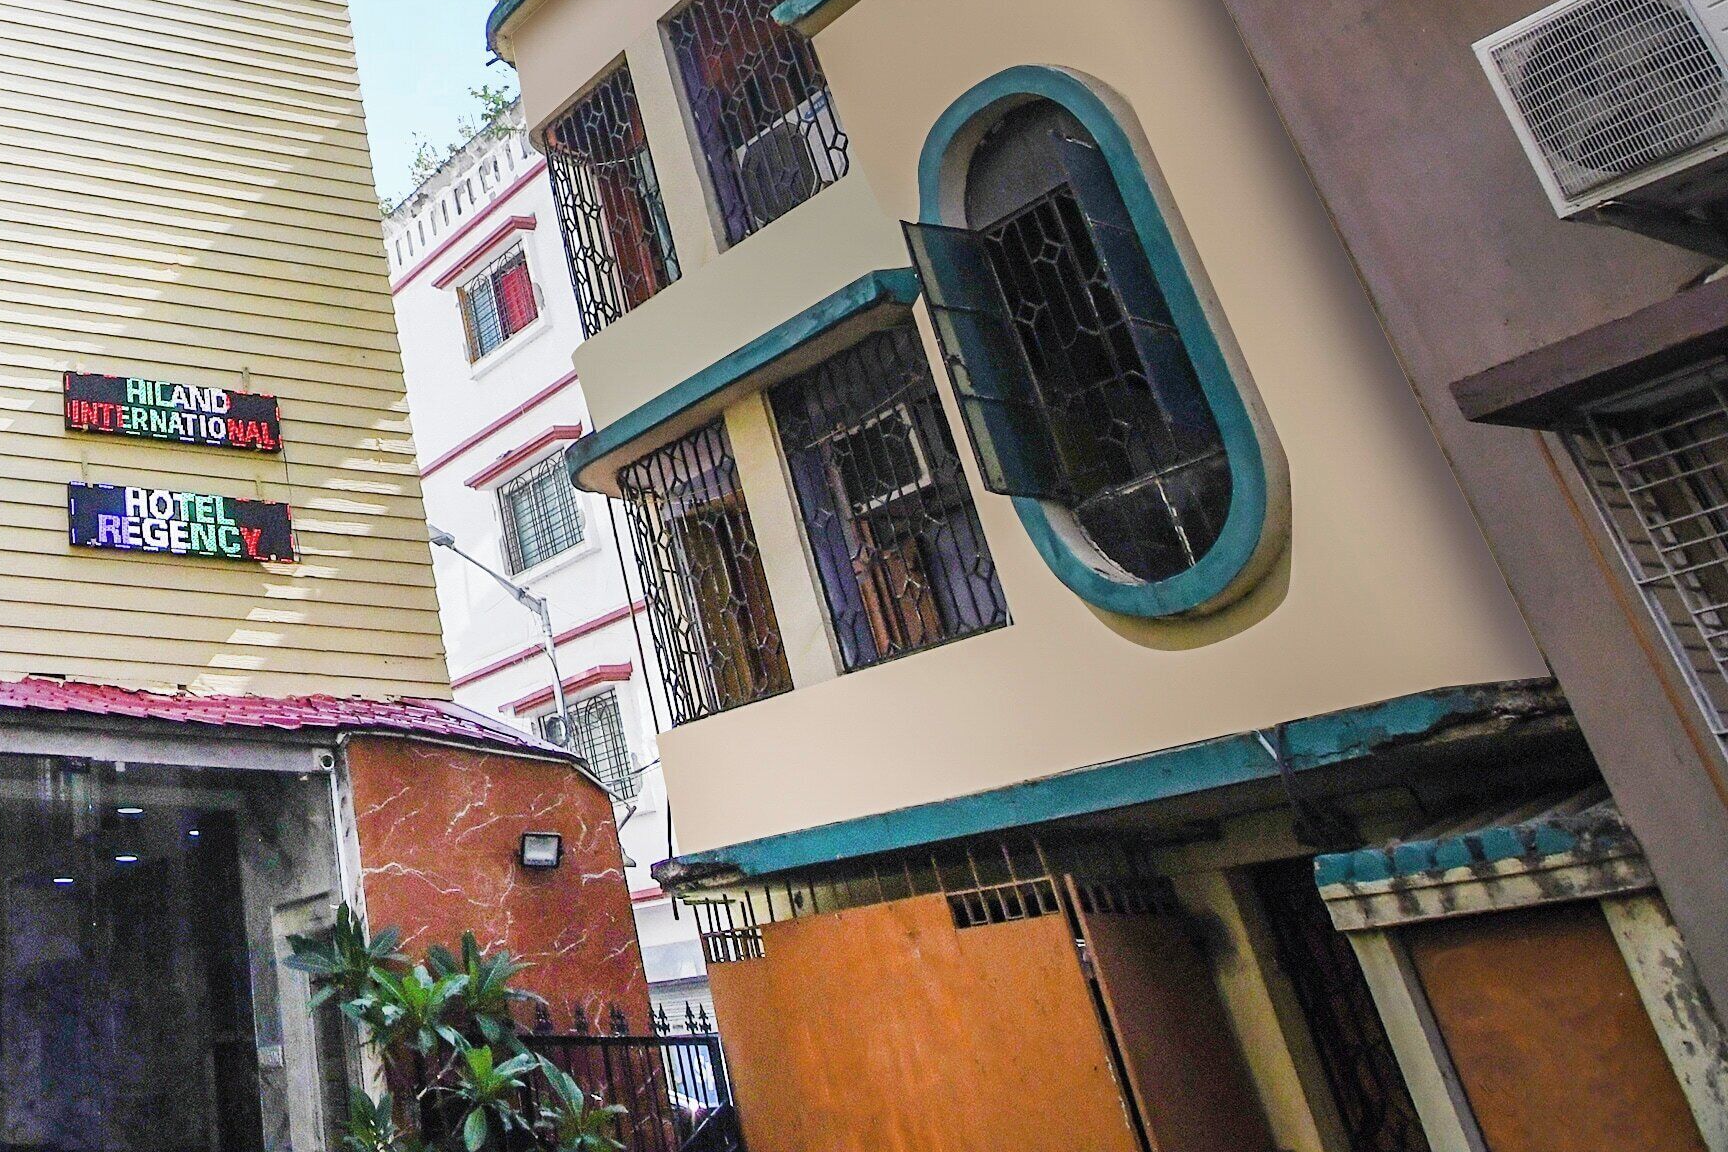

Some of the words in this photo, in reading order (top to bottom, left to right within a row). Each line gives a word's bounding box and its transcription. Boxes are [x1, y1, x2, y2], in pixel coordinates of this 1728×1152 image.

[126, 378, 231, 415] HILAND
[72, 400, 275, 445] INTERNATIONAL
[125, 486, 235, 527] HOTEL
[98, 513, 262, 556] REGENCY
